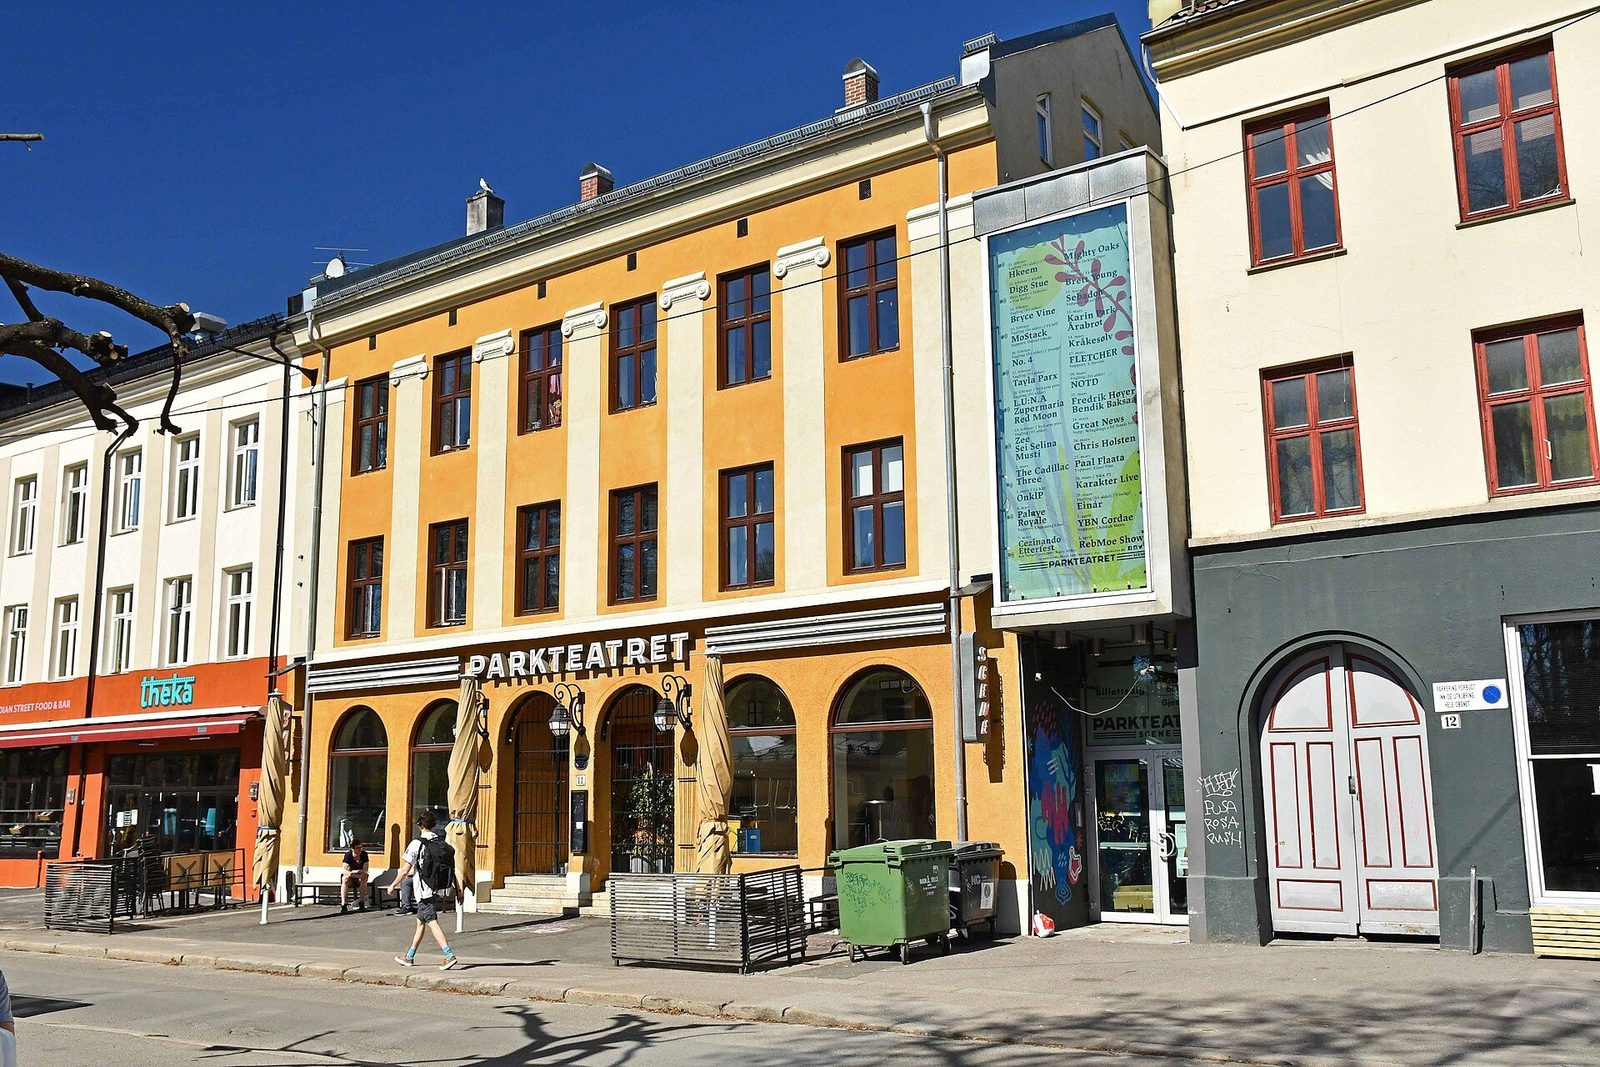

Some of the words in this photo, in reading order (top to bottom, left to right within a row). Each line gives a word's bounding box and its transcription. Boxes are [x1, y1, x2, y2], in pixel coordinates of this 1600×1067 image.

[1064, 249, 1096, 261] Mighty
[1098, 242, 1120, 253] Oaks
[1009, 267, 1038, 278] Hkeem
[1066, 277, 1089, 286] Brett
[1091, 270, 1118, 281] Young
[1010, 284, 1028, 294] Digg
[1030, 280, 1048, 289] Stue
[1010, 314, 1034, 324] Bryce
[1036, 308, 1056, 317] Vine
[1067, 312, 1094, 322] Karin
[1011, 329, 1048, 343] MoStack
[1068, 333, 1113, 348] Kråkesølv
[1012, 359, 1026, 367] No.
[1069, 348, 1118, 364] FLETCHER
[1013, 376, 1036, 387] Tayla
[1038, 373, 1058, 382] Parx
[1070, 378, 1099, 388] NOTD
[1072, 393, 1106, 405] Fredrik
[1108, 388, 1135, 400] Høyer
[1014, 400, 1064, 415] Zupermaria
[1072, 402, 1104, 414] Bendik
[1014, 415, 1030, 424] Red
[1032, 412, 1058, 421] Moon
[1073, 420, 1099, 430] Great
[1102, 416, 1125, 426] News
[1015, 436, 1030, 445] Zee
[1015, 444, 1028, 453] Sei
[1030, 441, 1057, 451] Selina
[1074, 440, 1099, 451] Chris
[1102, 436, 1136, 448] Holsten
[1016, 450, 1041, 461] Musti
[1075, 458, 1095, 468] Paal
[1098, 454, 1125, 465] Flaata
[1016, 469, 1032, 478] The
[1034, 463, 1070, 475] Cadillac
[1016, 477, 1042, 486] Three
[1076, 478, 1118, 489] Karakter
[1120, 474, 1139, 483] Live
[1077, 501, 1103, 510] Einár
[1018, 509, 1046, 519] Palaye
[1078, 518, 1099, 527] YBN
[1102, 514, 1134, 524] Cordae
[1018, 518, 1047, 528] Royale
[1019, 536, 1062, 548] Cezinando
[1079, 538, 1117, 549] RebMoe
[1120, 535, 1144, 545] Show
[1019, 545, 1055, 555] Etterfest
[1048, 554, 1116, 569] PARKTEATRET
[469, 631, 690, 679] PARKTEATRET
[140, 674, 196, 709] theka
[977, 646, 990, 735] SCENE
[13, 703, 36, 713] STREET
[35, 701, 53, 711] FOOD
[53, 701, 58, 710] &
[58, 700, 71, 708] BAR
[1445, 716, 1457, 727] 12
[1138, 730, 1171, 738] SCENE
